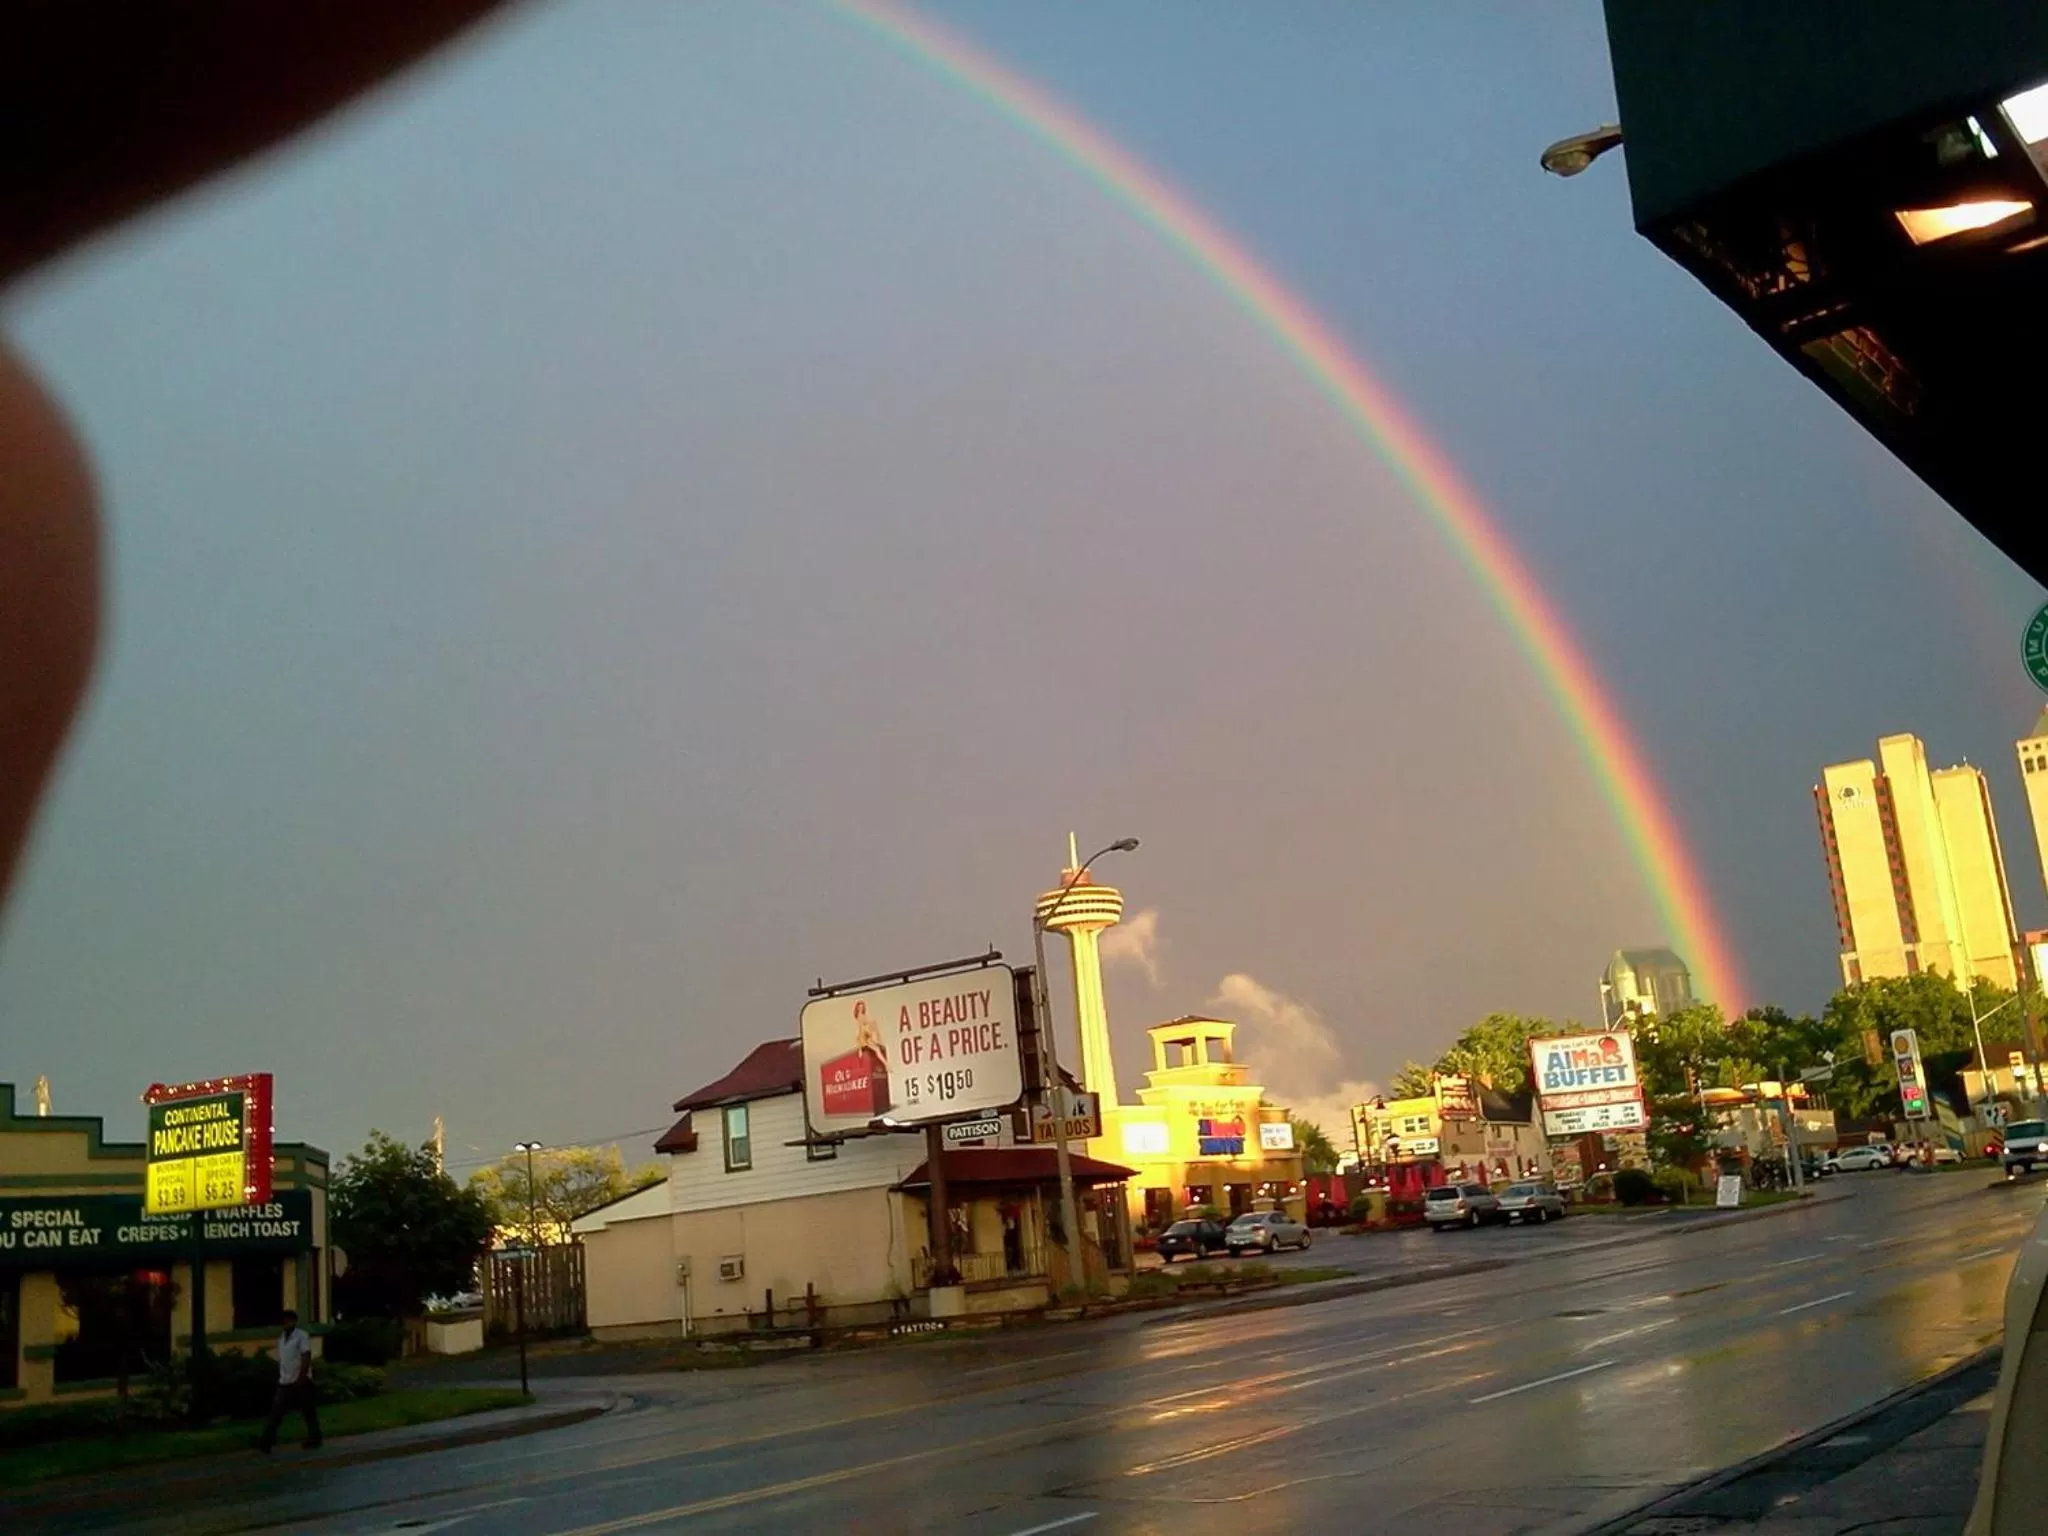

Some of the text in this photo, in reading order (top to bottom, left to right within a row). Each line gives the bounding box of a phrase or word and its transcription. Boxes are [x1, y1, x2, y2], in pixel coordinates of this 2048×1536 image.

[899, 989, 991, 1033] A BEAUTY
[901, 1021, 1008, 1065] OF A PRICE.
[1544, 1064, 1628, 1089] BUFFET
[905, 1077, 919, 1098] 15
[164, 1101, 230, 1127] CONTINENTAL
[154, 1119, 239, 1156] PANCAKE HOUSE
[949, 1122, 999, 1139] PATTISON
[1038, 1119, 1091, 1140] TAOOS
[11, 1209, 85, 1228] SPECIAL
[216, 1203, 283, 1220] WAFFLES
[23, 1230, 62, 1248] CAN
[68, 1228, 102, 1246] EAT
[117, 1225, 180, 1242] CREPES
[252, 1220, 301, 1237] TOAST
